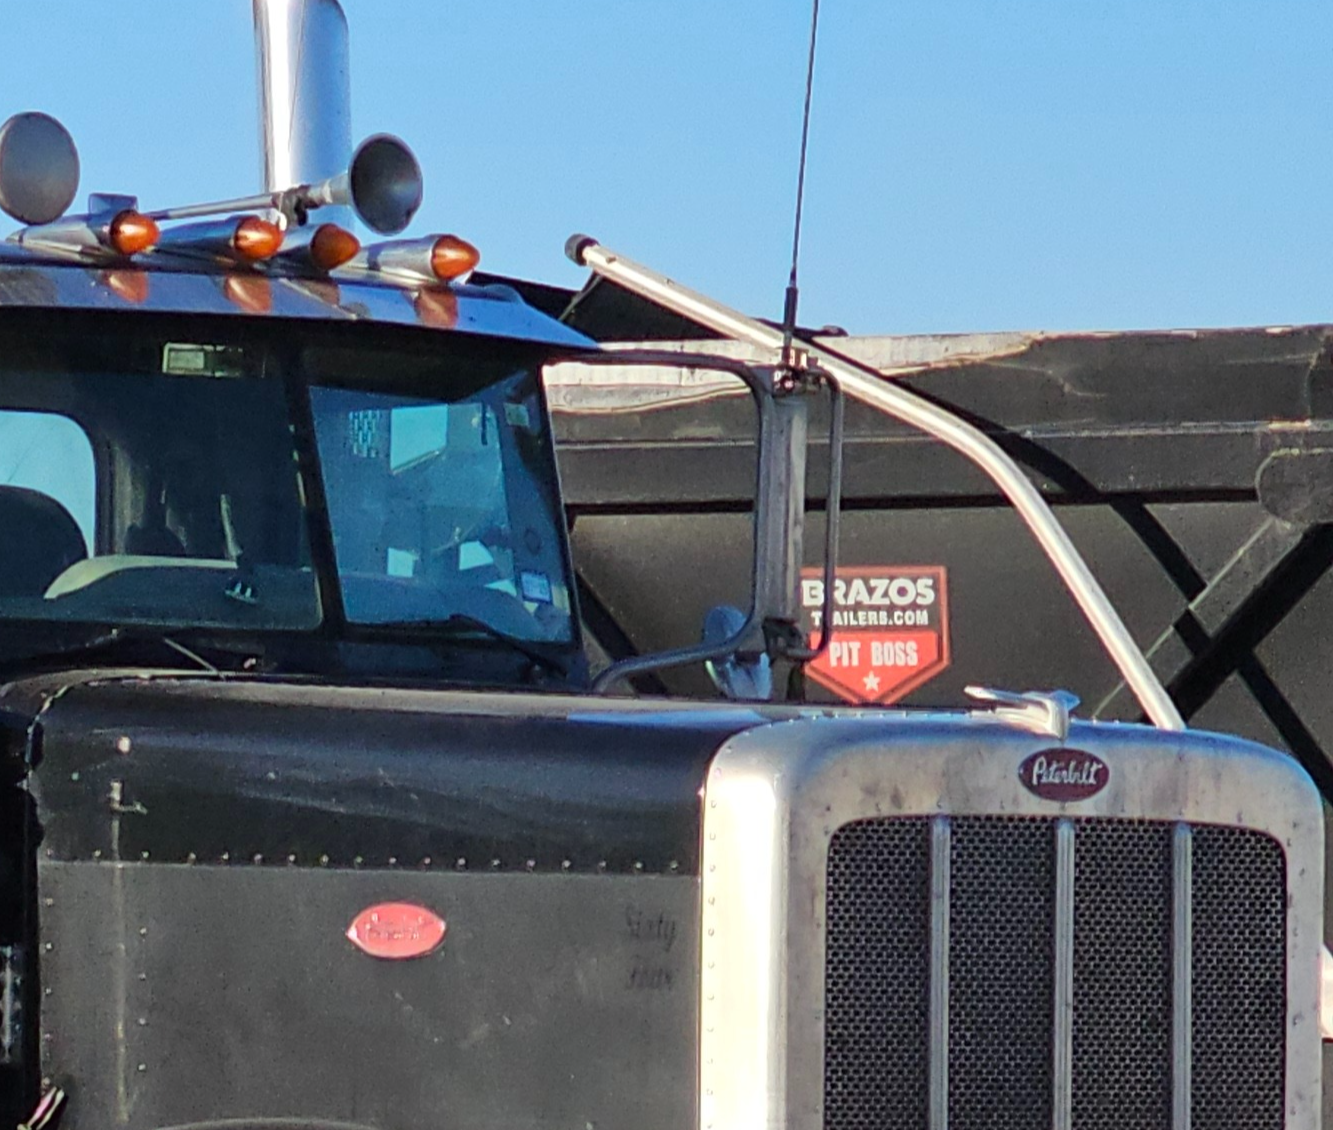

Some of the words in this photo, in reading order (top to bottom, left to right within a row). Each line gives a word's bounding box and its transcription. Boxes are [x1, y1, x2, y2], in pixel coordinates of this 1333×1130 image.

[801, 577, 935, 607] BRAZOS
[811, 610, 929, 626] TAILERS.COM
[829, 640, 861, 667] PIT
[870, 640, 919, 667] BOSS
[1033, 755, 1103, 786] Peterbilt
